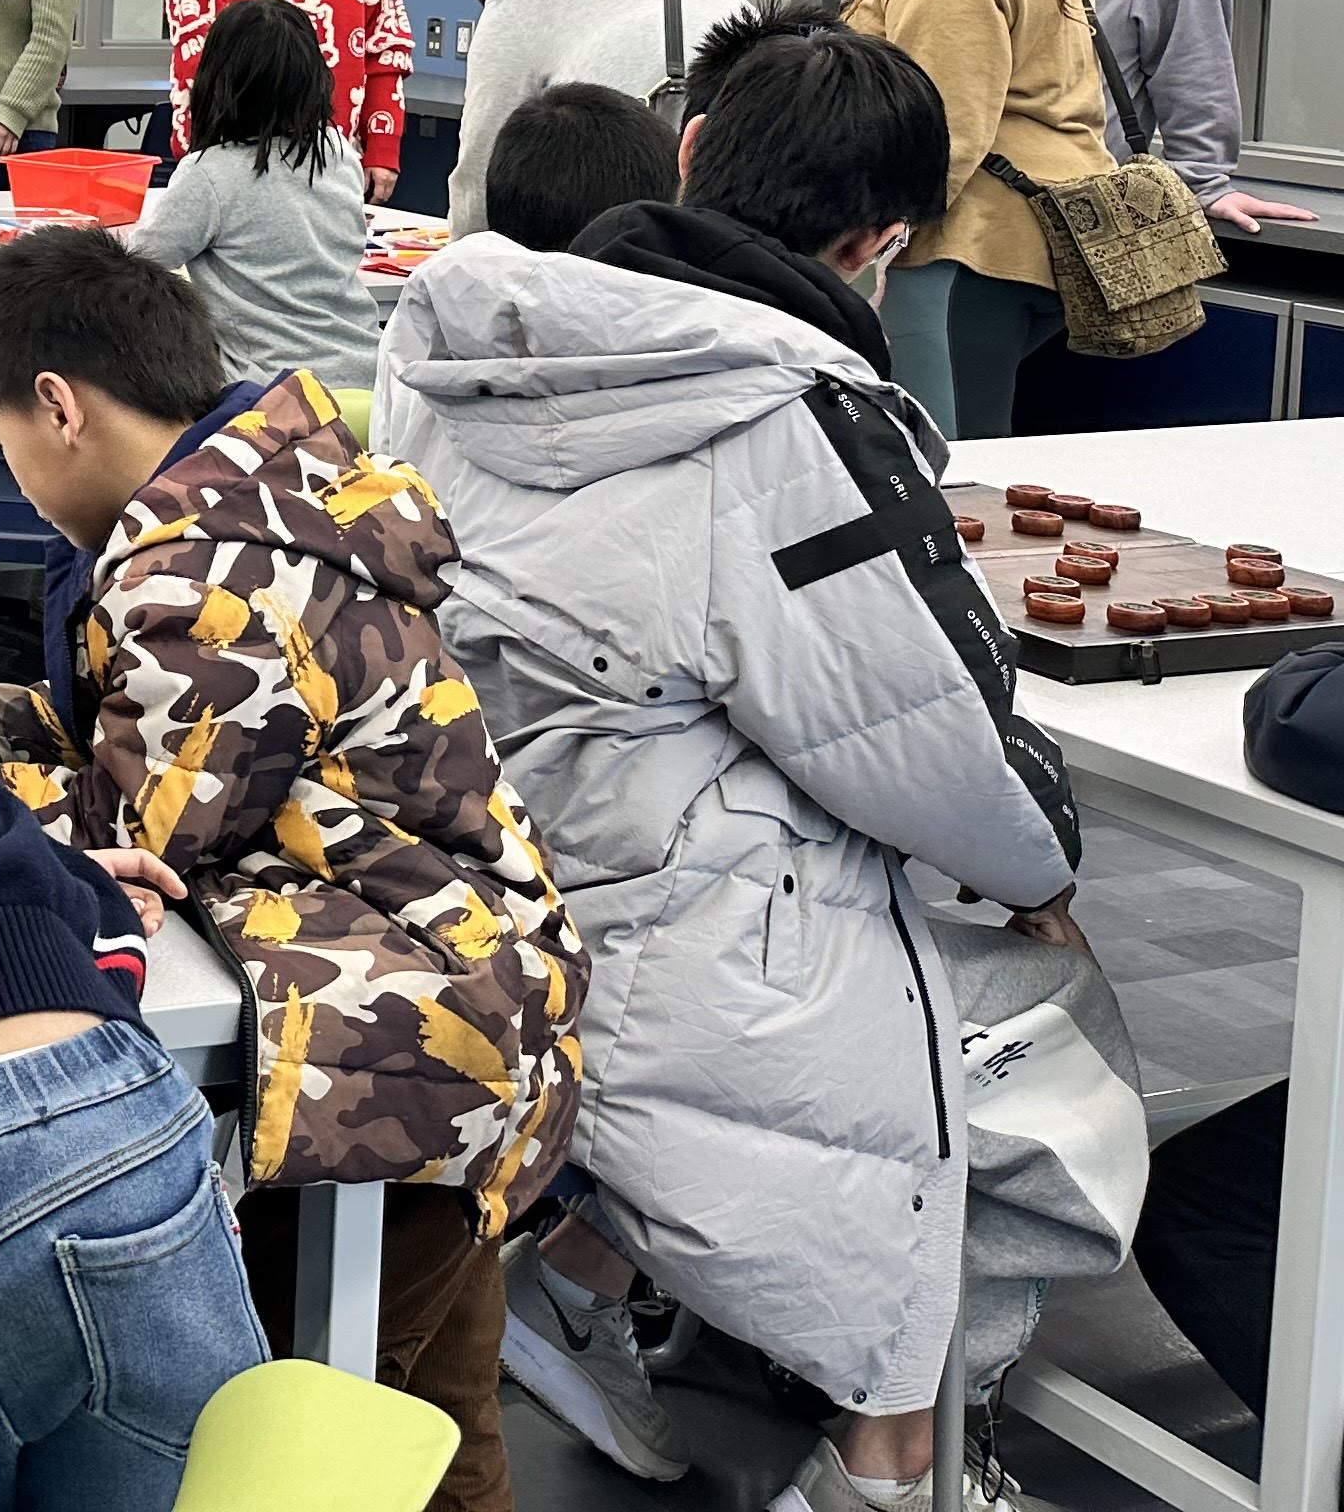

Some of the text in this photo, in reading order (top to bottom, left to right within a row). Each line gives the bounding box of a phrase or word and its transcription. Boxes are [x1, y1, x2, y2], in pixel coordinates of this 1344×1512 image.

[838, 393, 862, 424] SOUL
[923, 534, 942, 565] SOUL
[967, 609, 1001, 666] ORIGINAL
